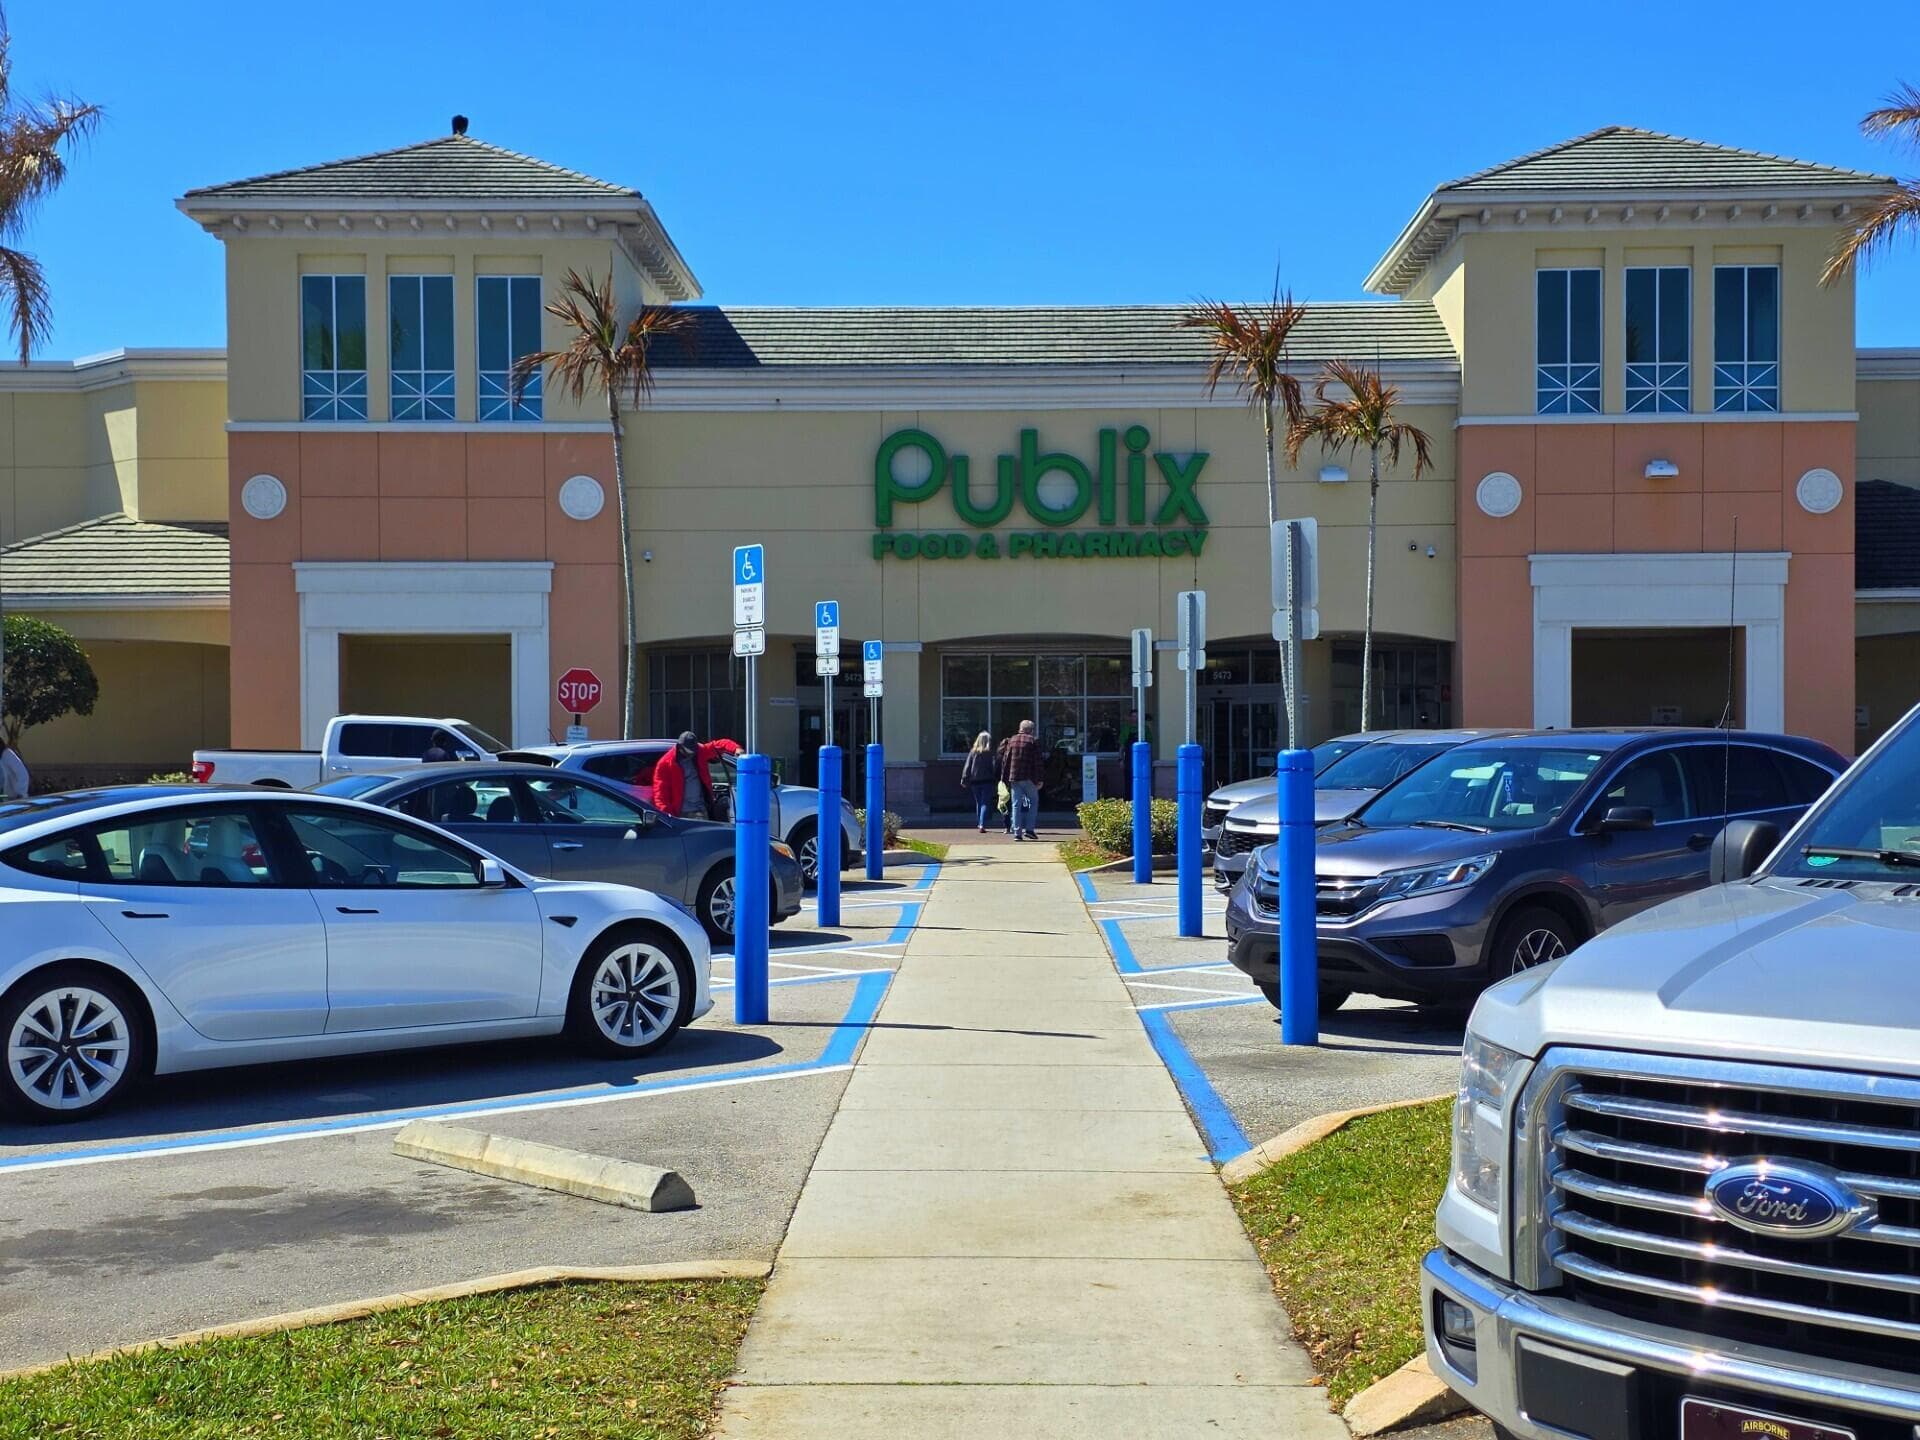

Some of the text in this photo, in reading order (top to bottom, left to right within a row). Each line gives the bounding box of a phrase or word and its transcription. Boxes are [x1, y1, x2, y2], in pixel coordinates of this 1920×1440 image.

[875, 425, 1210, 529] Publix
[873, 531, 1209, 561] FOOD & PHARMACY
[560, 682, 599, 700] STOP
[1736, 1183, 1808, 1221] Ford
[1742, 1420, 1790, 1440] AIRBORNE
